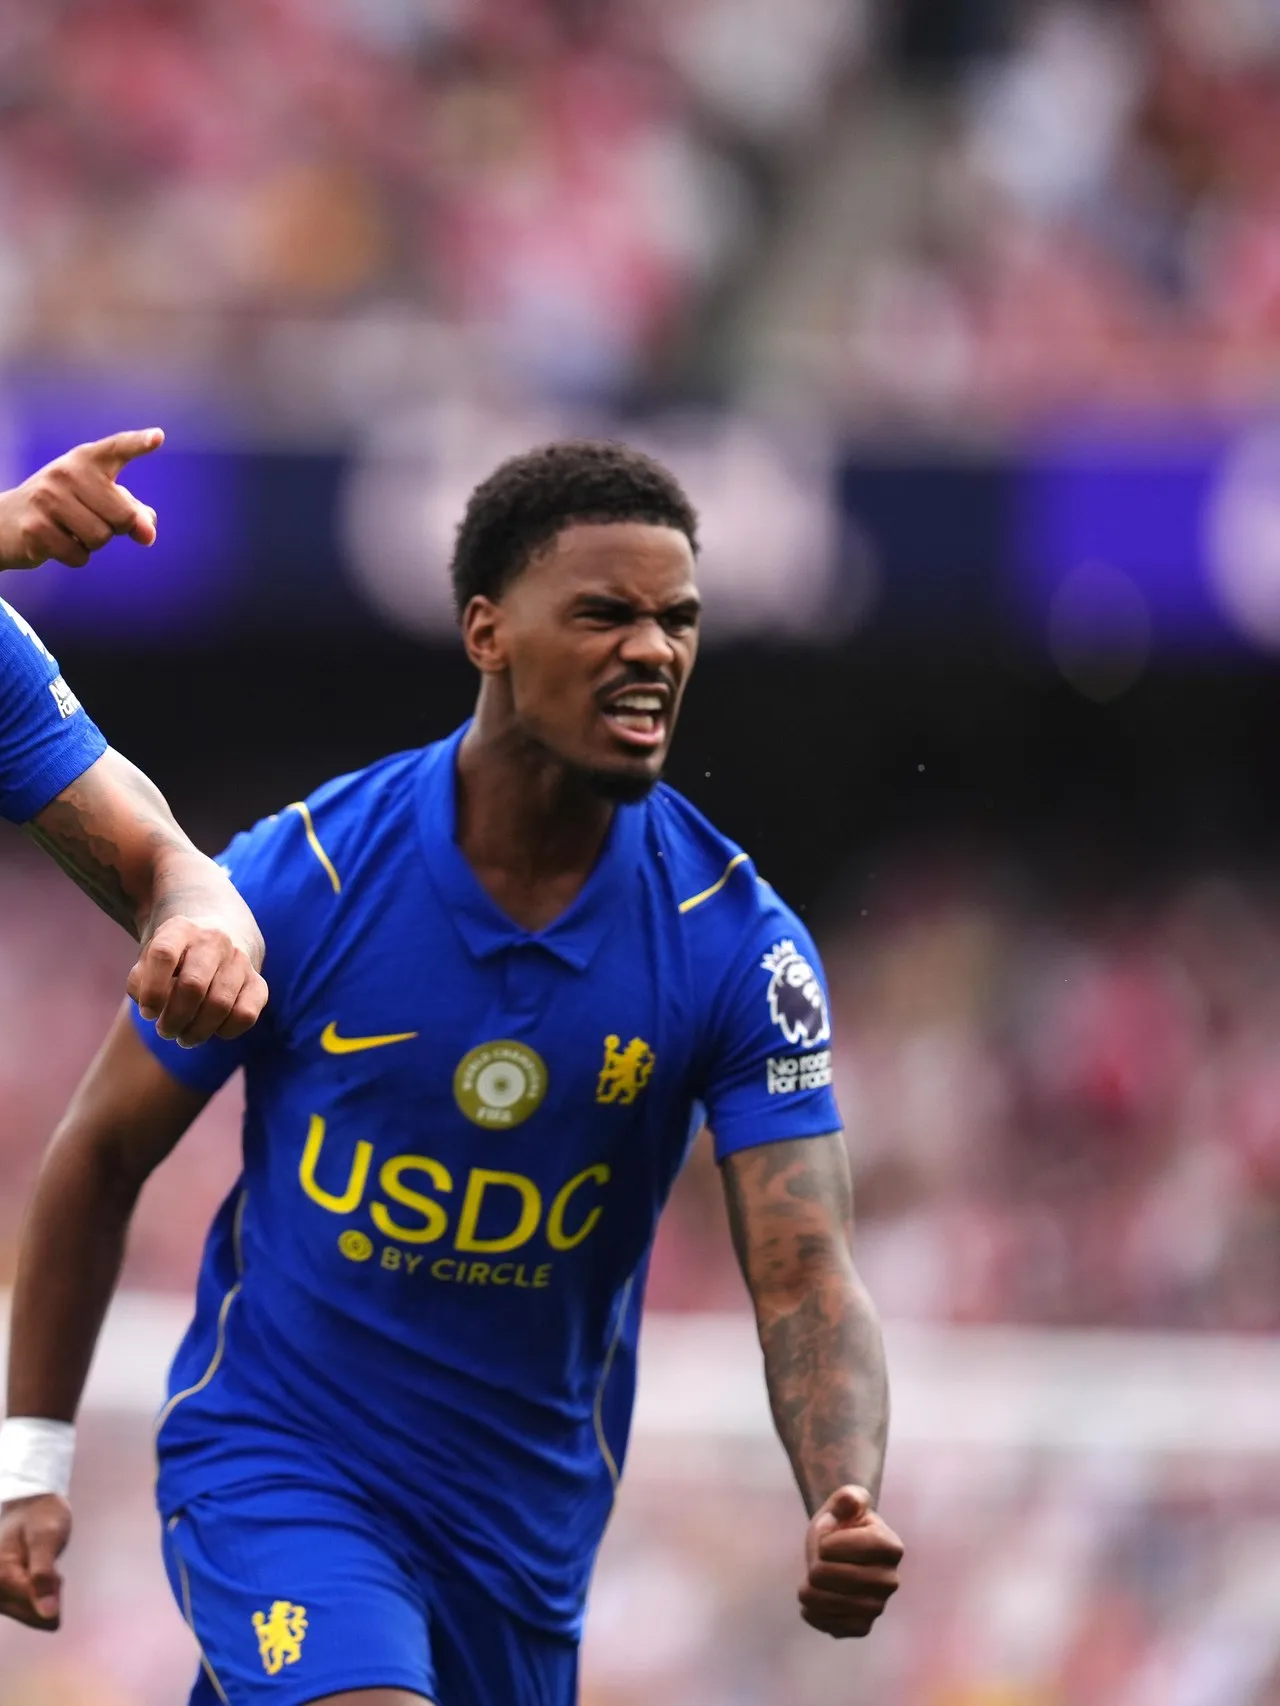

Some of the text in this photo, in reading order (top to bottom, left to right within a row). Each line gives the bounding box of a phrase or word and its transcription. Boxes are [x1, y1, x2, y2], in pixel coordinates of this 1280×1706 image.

[767, 1058, 799, 1077] No
[299, 1113, 610, 1254] USDC
[380, 1246, 553, 1288] BY CIRCLE
